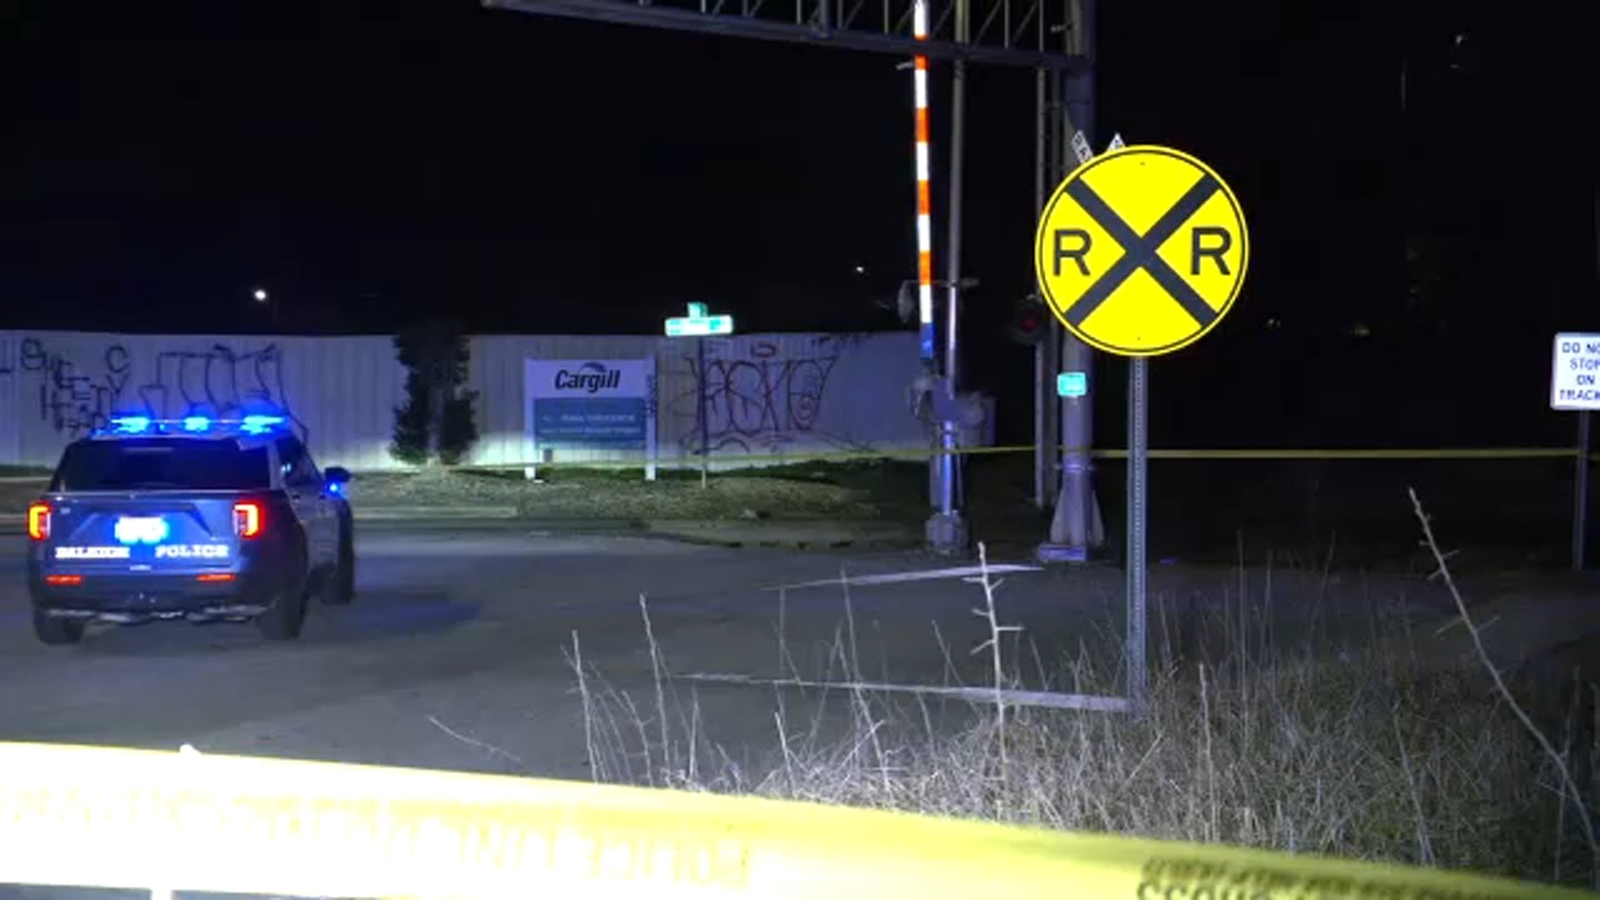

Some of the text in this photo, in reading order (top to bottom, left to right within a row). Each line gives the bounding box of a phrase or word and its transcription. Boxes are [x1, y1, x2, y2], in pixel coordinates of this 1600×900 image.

[1053, 226, 1232, 276] R R
[1561, 341, 1581, 354] DO
[554, 369, 621, 393] Cargill
[1576, 374, 1596, 386] ON
[155, 545, 230, 558] POLICE
